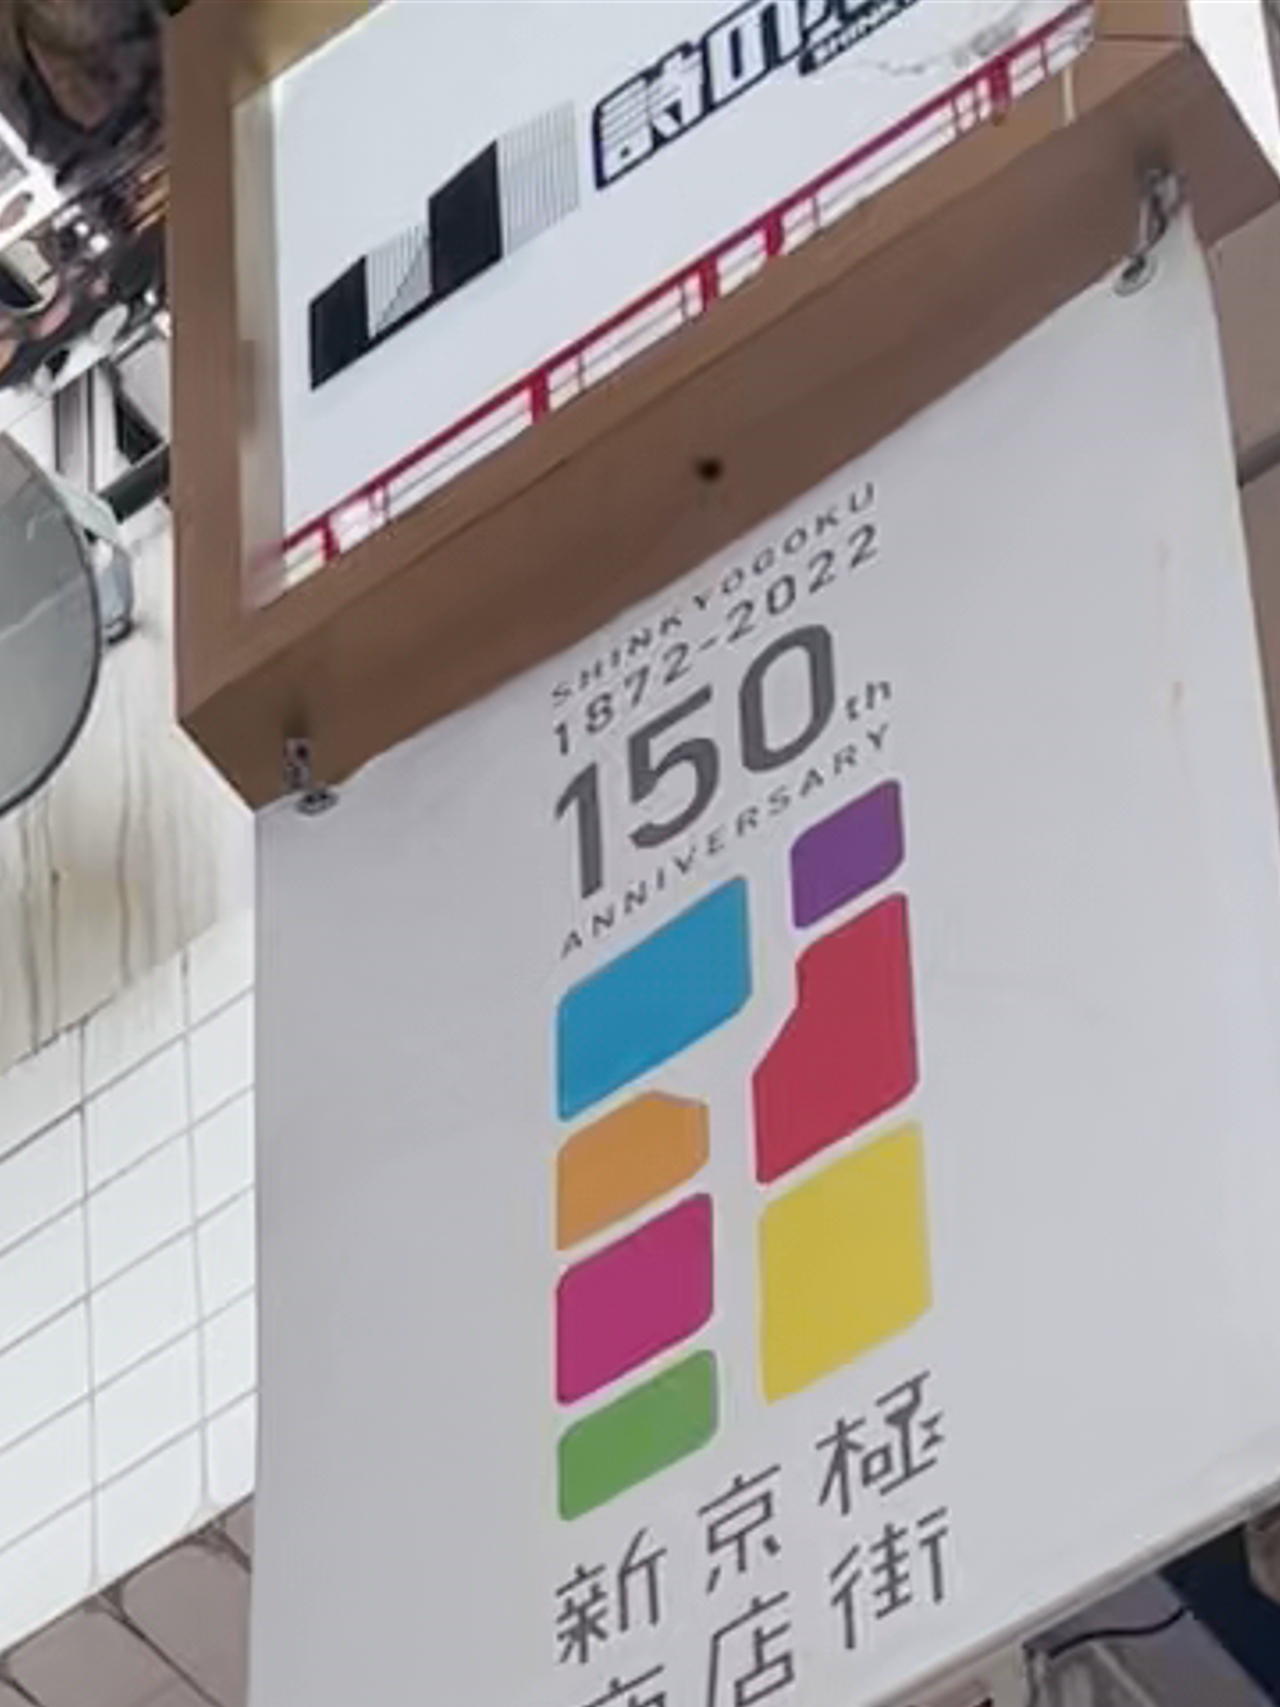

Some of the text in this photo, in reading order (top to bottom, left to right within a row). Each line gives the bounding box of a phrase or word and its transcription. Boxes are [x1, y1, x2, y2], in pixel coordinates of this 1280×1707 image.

[552, 482, 876, 708] SHINKYOGOKU
[554, 524, 880, 757] 1872-2022
[560, 724, 890, 960] ANNIVERSARY
[555, 1372, 946, 1668] 新京極
